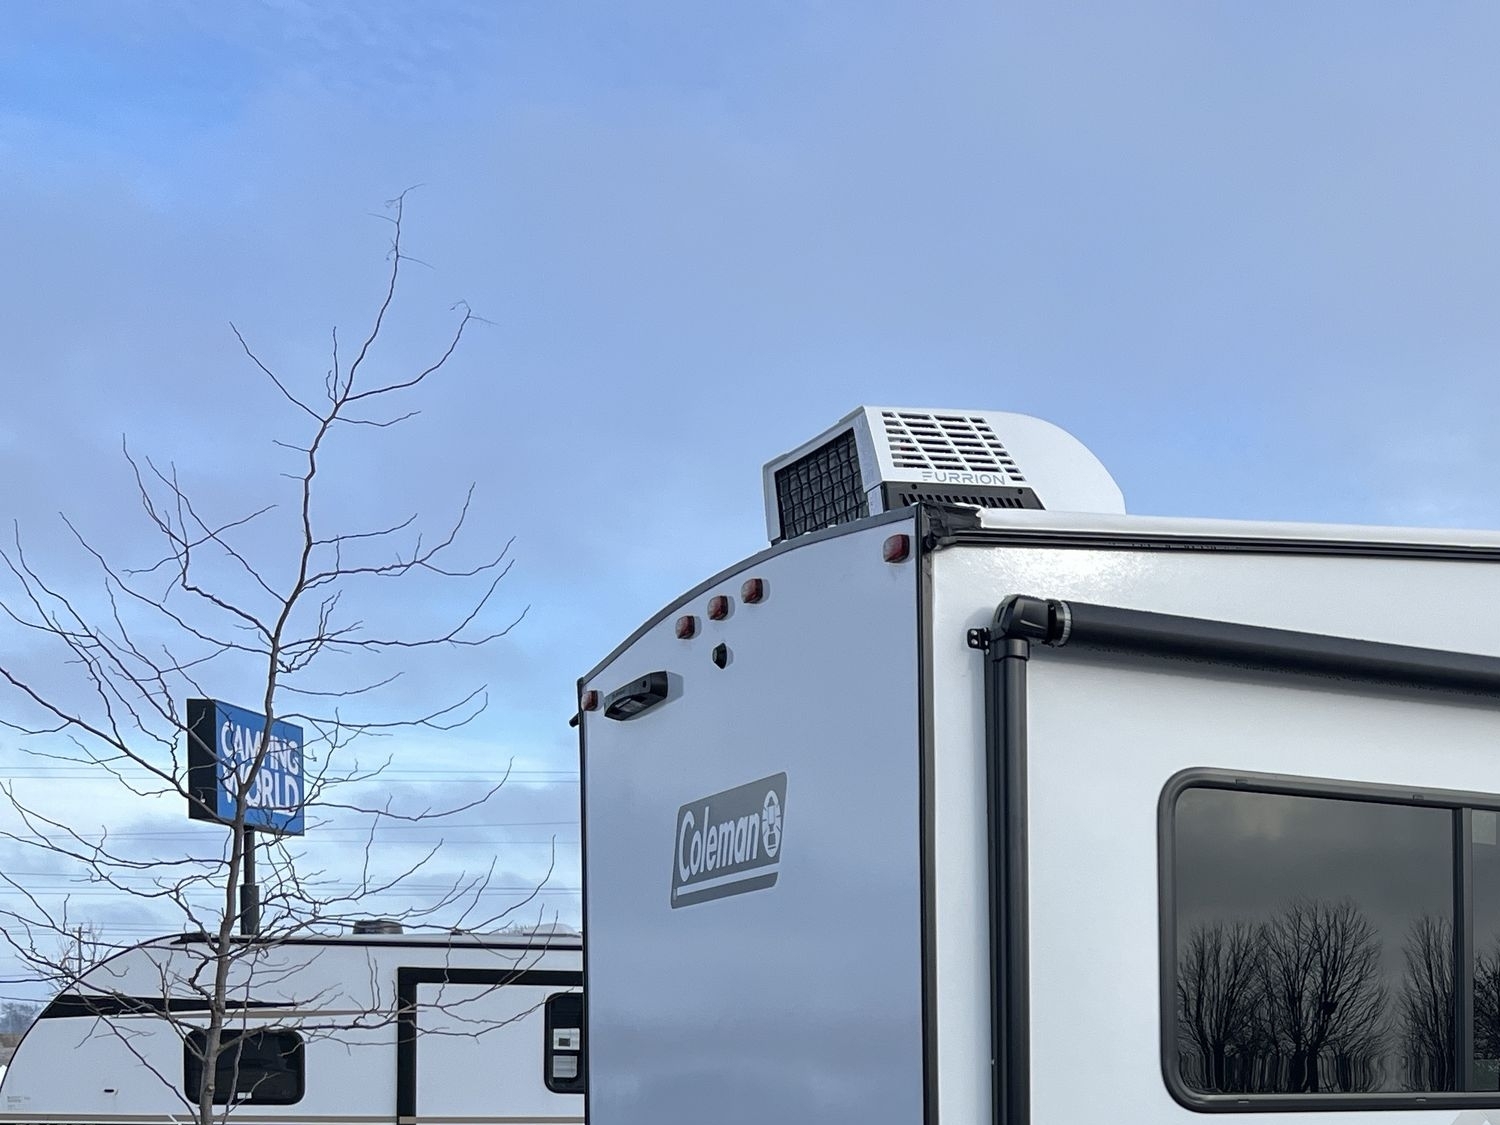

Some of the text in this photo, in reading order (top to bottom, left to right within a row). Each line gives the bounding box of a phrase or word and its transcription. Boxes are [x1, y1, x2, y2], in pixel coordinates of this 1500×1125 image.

[921, 471, 1006, 485] FURRION
[222, 757, 300, 816] WORLD
[678, 805, 760, 882] Coleman
